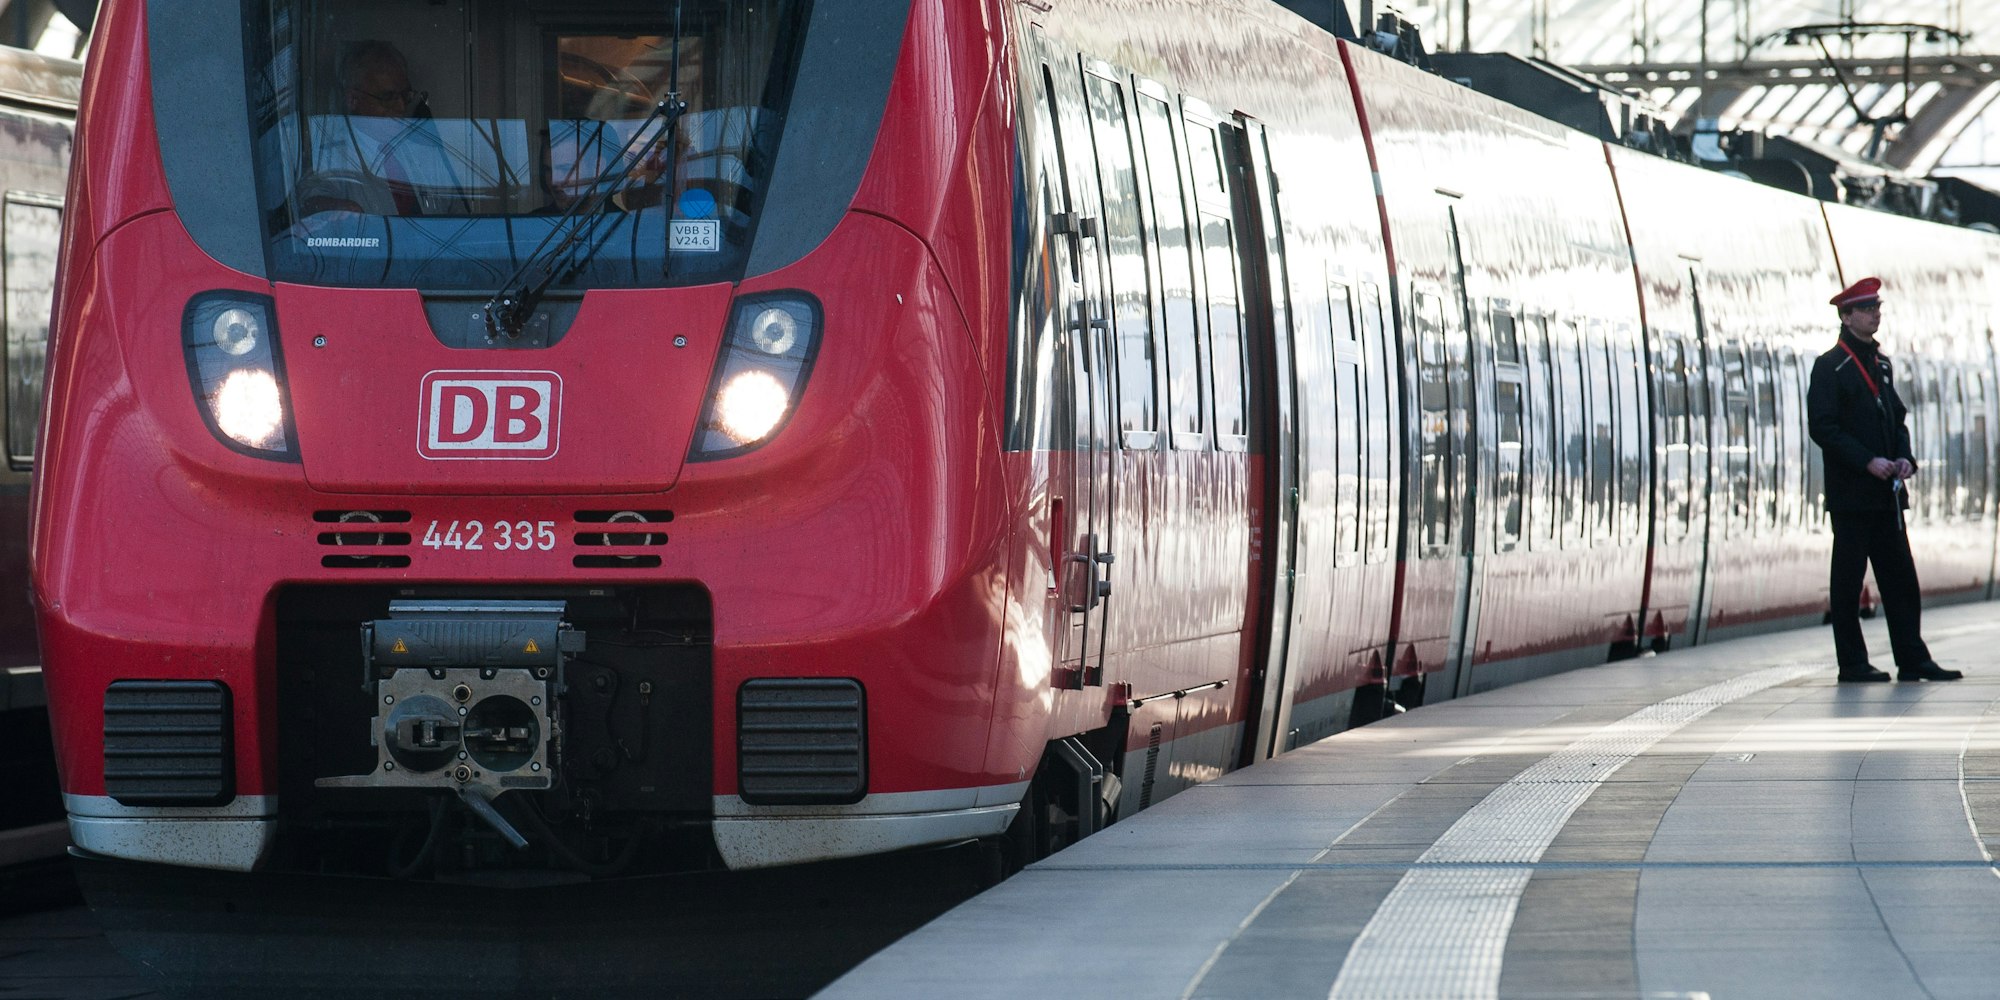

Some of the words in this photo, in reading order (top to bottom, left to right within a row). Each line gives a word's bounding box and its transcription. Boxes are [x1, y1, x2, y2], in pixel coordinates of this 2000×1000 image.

[675, 226, 699, 235] VBB
[703, 226, 710, 235] 5
[307, 237, 379, 248] BOMBARDIER
[675, 236, 710, 245] V24.6
[437, 386, 542, 443] DB
[422, 520, 484, 550] 442
[493, 520, 556, 551] 335
